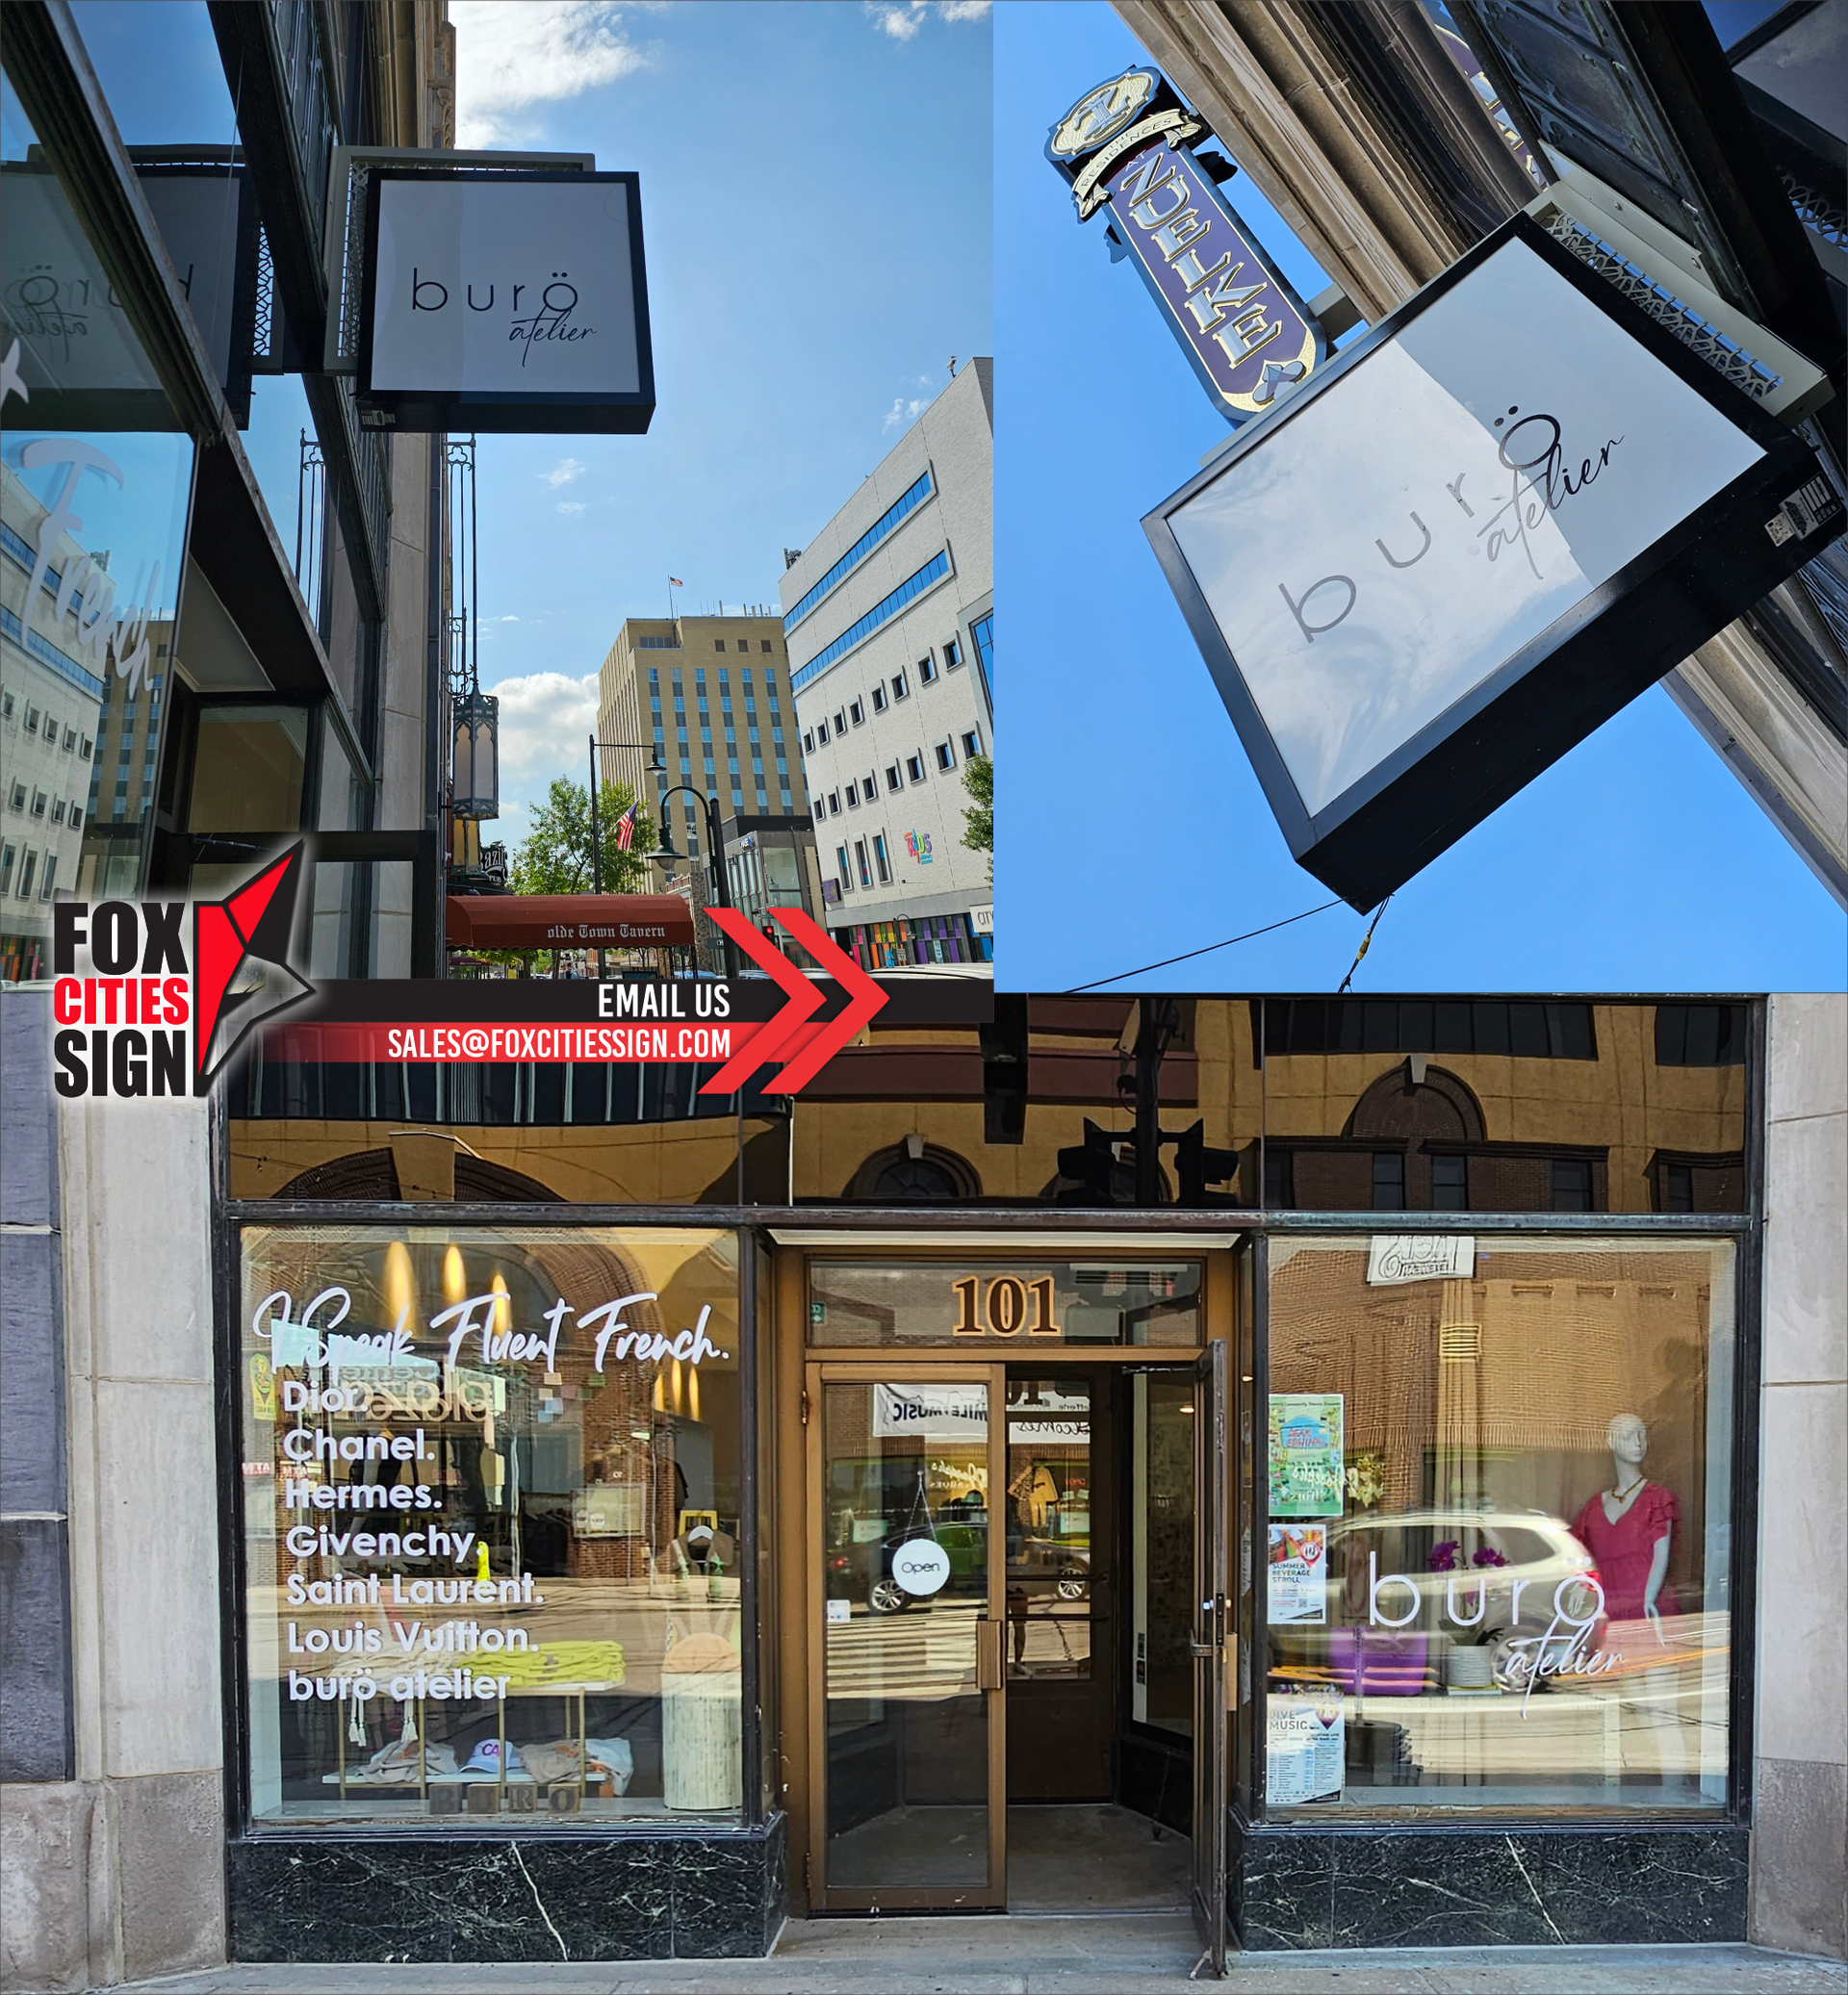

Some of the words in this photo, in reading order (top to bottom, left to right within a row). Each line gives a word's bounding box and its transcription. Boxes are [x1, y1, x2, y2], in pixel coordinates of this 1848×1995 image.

[1080, 116, 1173, 188] RESIDENCES
[1108, 131, 1133, 149] THE
[1124, 149, 1146, 172] AT
[412, 267, 578, 312] burö
[508, 304, 599, 368] atelier
[1476, 434, 1626, 580] atelier
[1277, 404, 1561, 645] burö
[578, 924, 616, 938] Town
[619, 923, 665, 938] Tavern
[951, 1275, 1061, 1338] 101
[301, 1287, 415, 1386] Speak
[429, 1292, 575, 1373] Fluent
[578, 1291, 731, 1373] French.
[283, 1381, 370, 1412] Dior.
[283, 1428, 436, 1461] Chanel.
[285, 1479, 443, 1509] Hermes.
[286, 1524, 482, 1564] Givenchy.
[901, 1561, 940, 1575] Open
[287, 1573, 381, 1605] Saint
[392, 1573, 545, 1605] Laurent.
[1369, 1550, 1605, 1627] burö
[288, 1621, 382, 1653] Louis
[394, 1620, 540, 1653] Vuitton.
[289, 1667, 376, 1701] burö
[388, 1668, 511, 1702] atelier
[1504, 1616, 1625, 1721] atelier
[1269, 1721, 1308, 1730] MUSIC
[1270, 1710, 1296, 1720] LIVE
